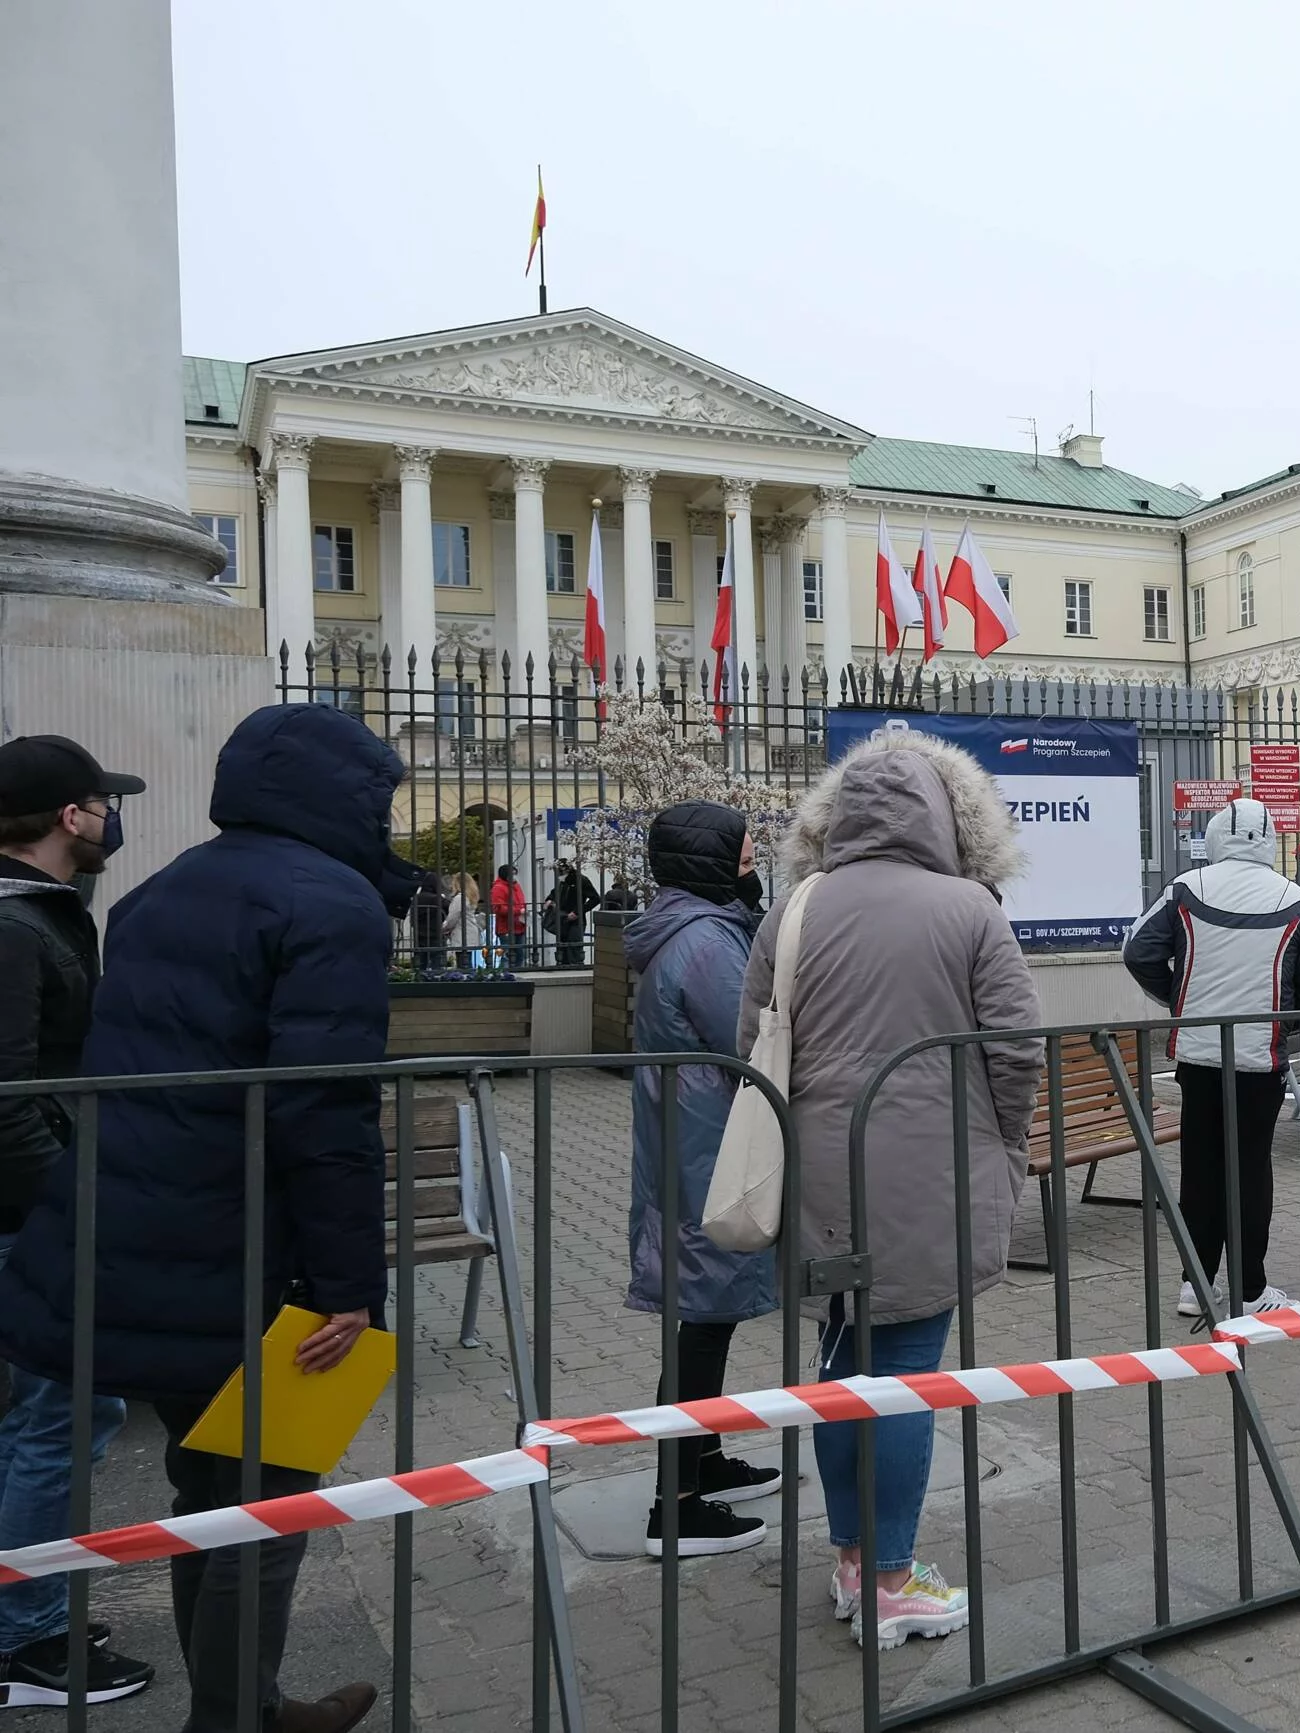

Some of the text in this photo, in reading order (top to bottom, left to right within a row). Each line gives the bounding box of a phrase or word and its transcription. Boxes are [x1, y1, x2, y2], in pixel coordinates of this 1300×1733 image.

[1033, 738, 1077, 749] Narodowy
[1033, 748, 1111, 758] Program Szczepień
